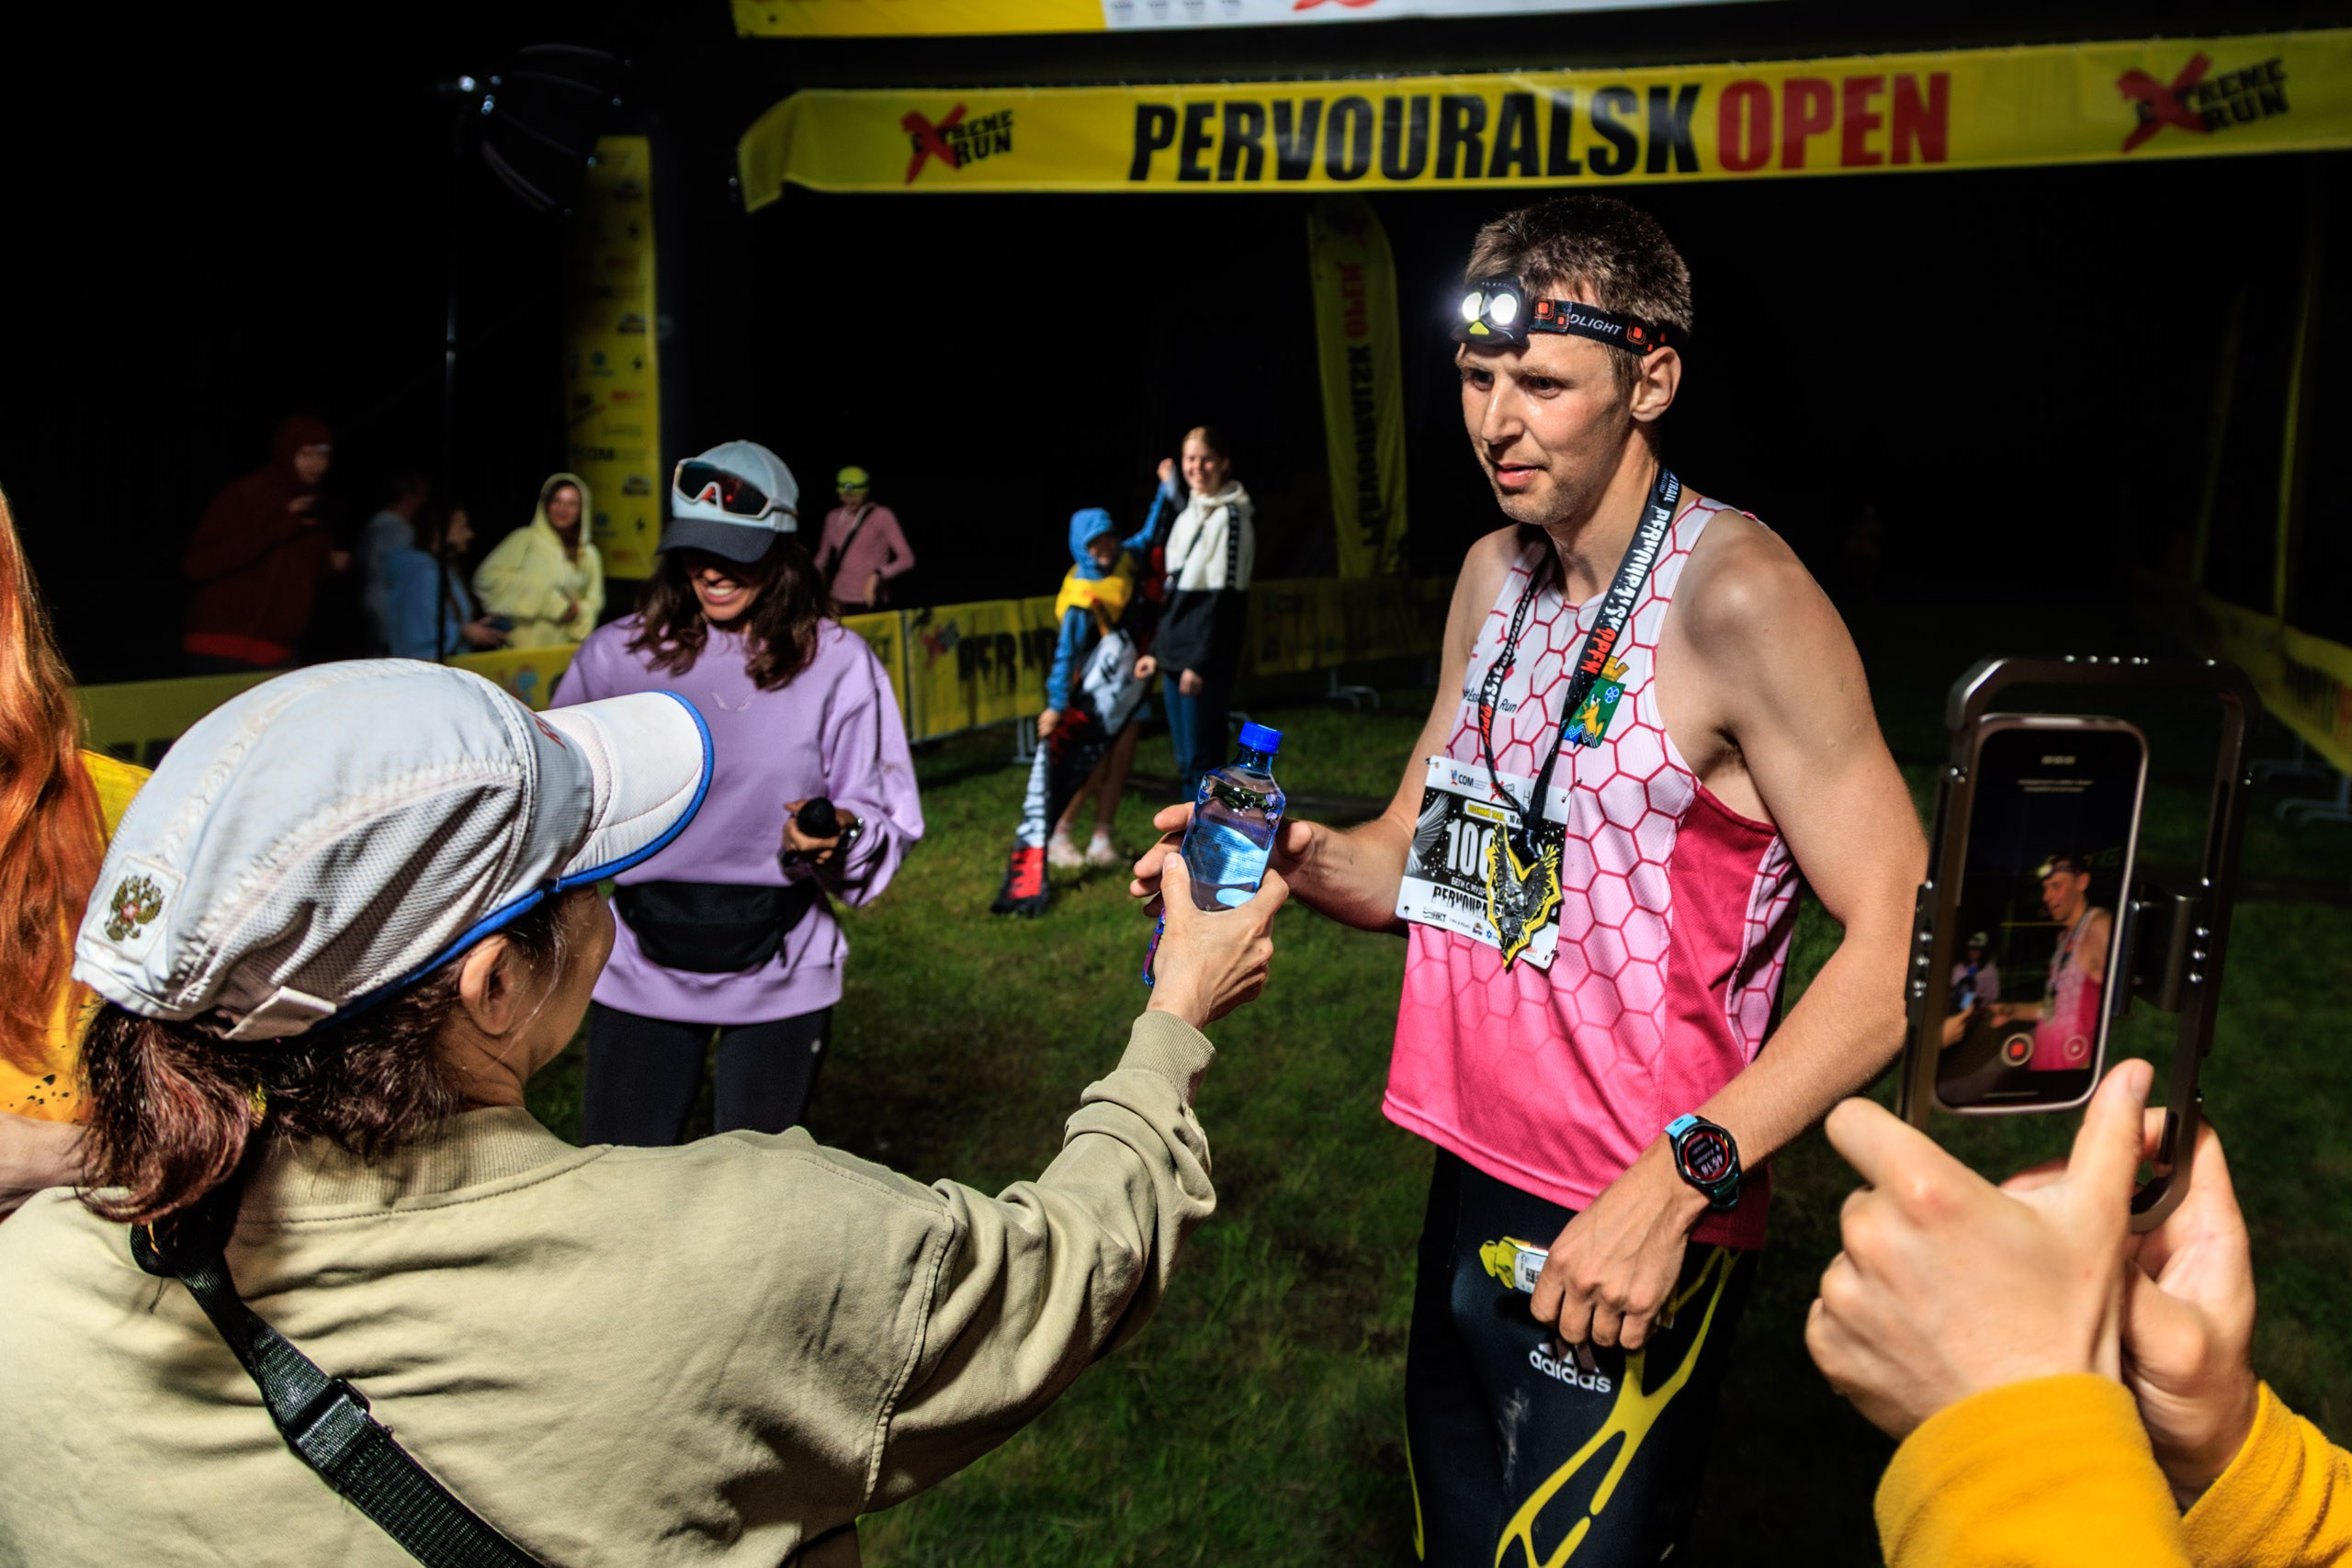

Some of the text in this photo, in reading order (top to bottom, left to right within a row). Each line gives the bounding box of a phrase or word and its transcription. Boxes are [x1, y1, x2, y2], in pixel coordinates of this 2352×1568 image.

[1129, 72, 1951, 183] PERVOURALSK OPEN
[2201, 85, 2289, 134] RUN
[954, 129, 1012, 169] RUN
[1569, 314, 1623, 335] DLIGHT
[1529, 1348, 1611, 1393] adidas
